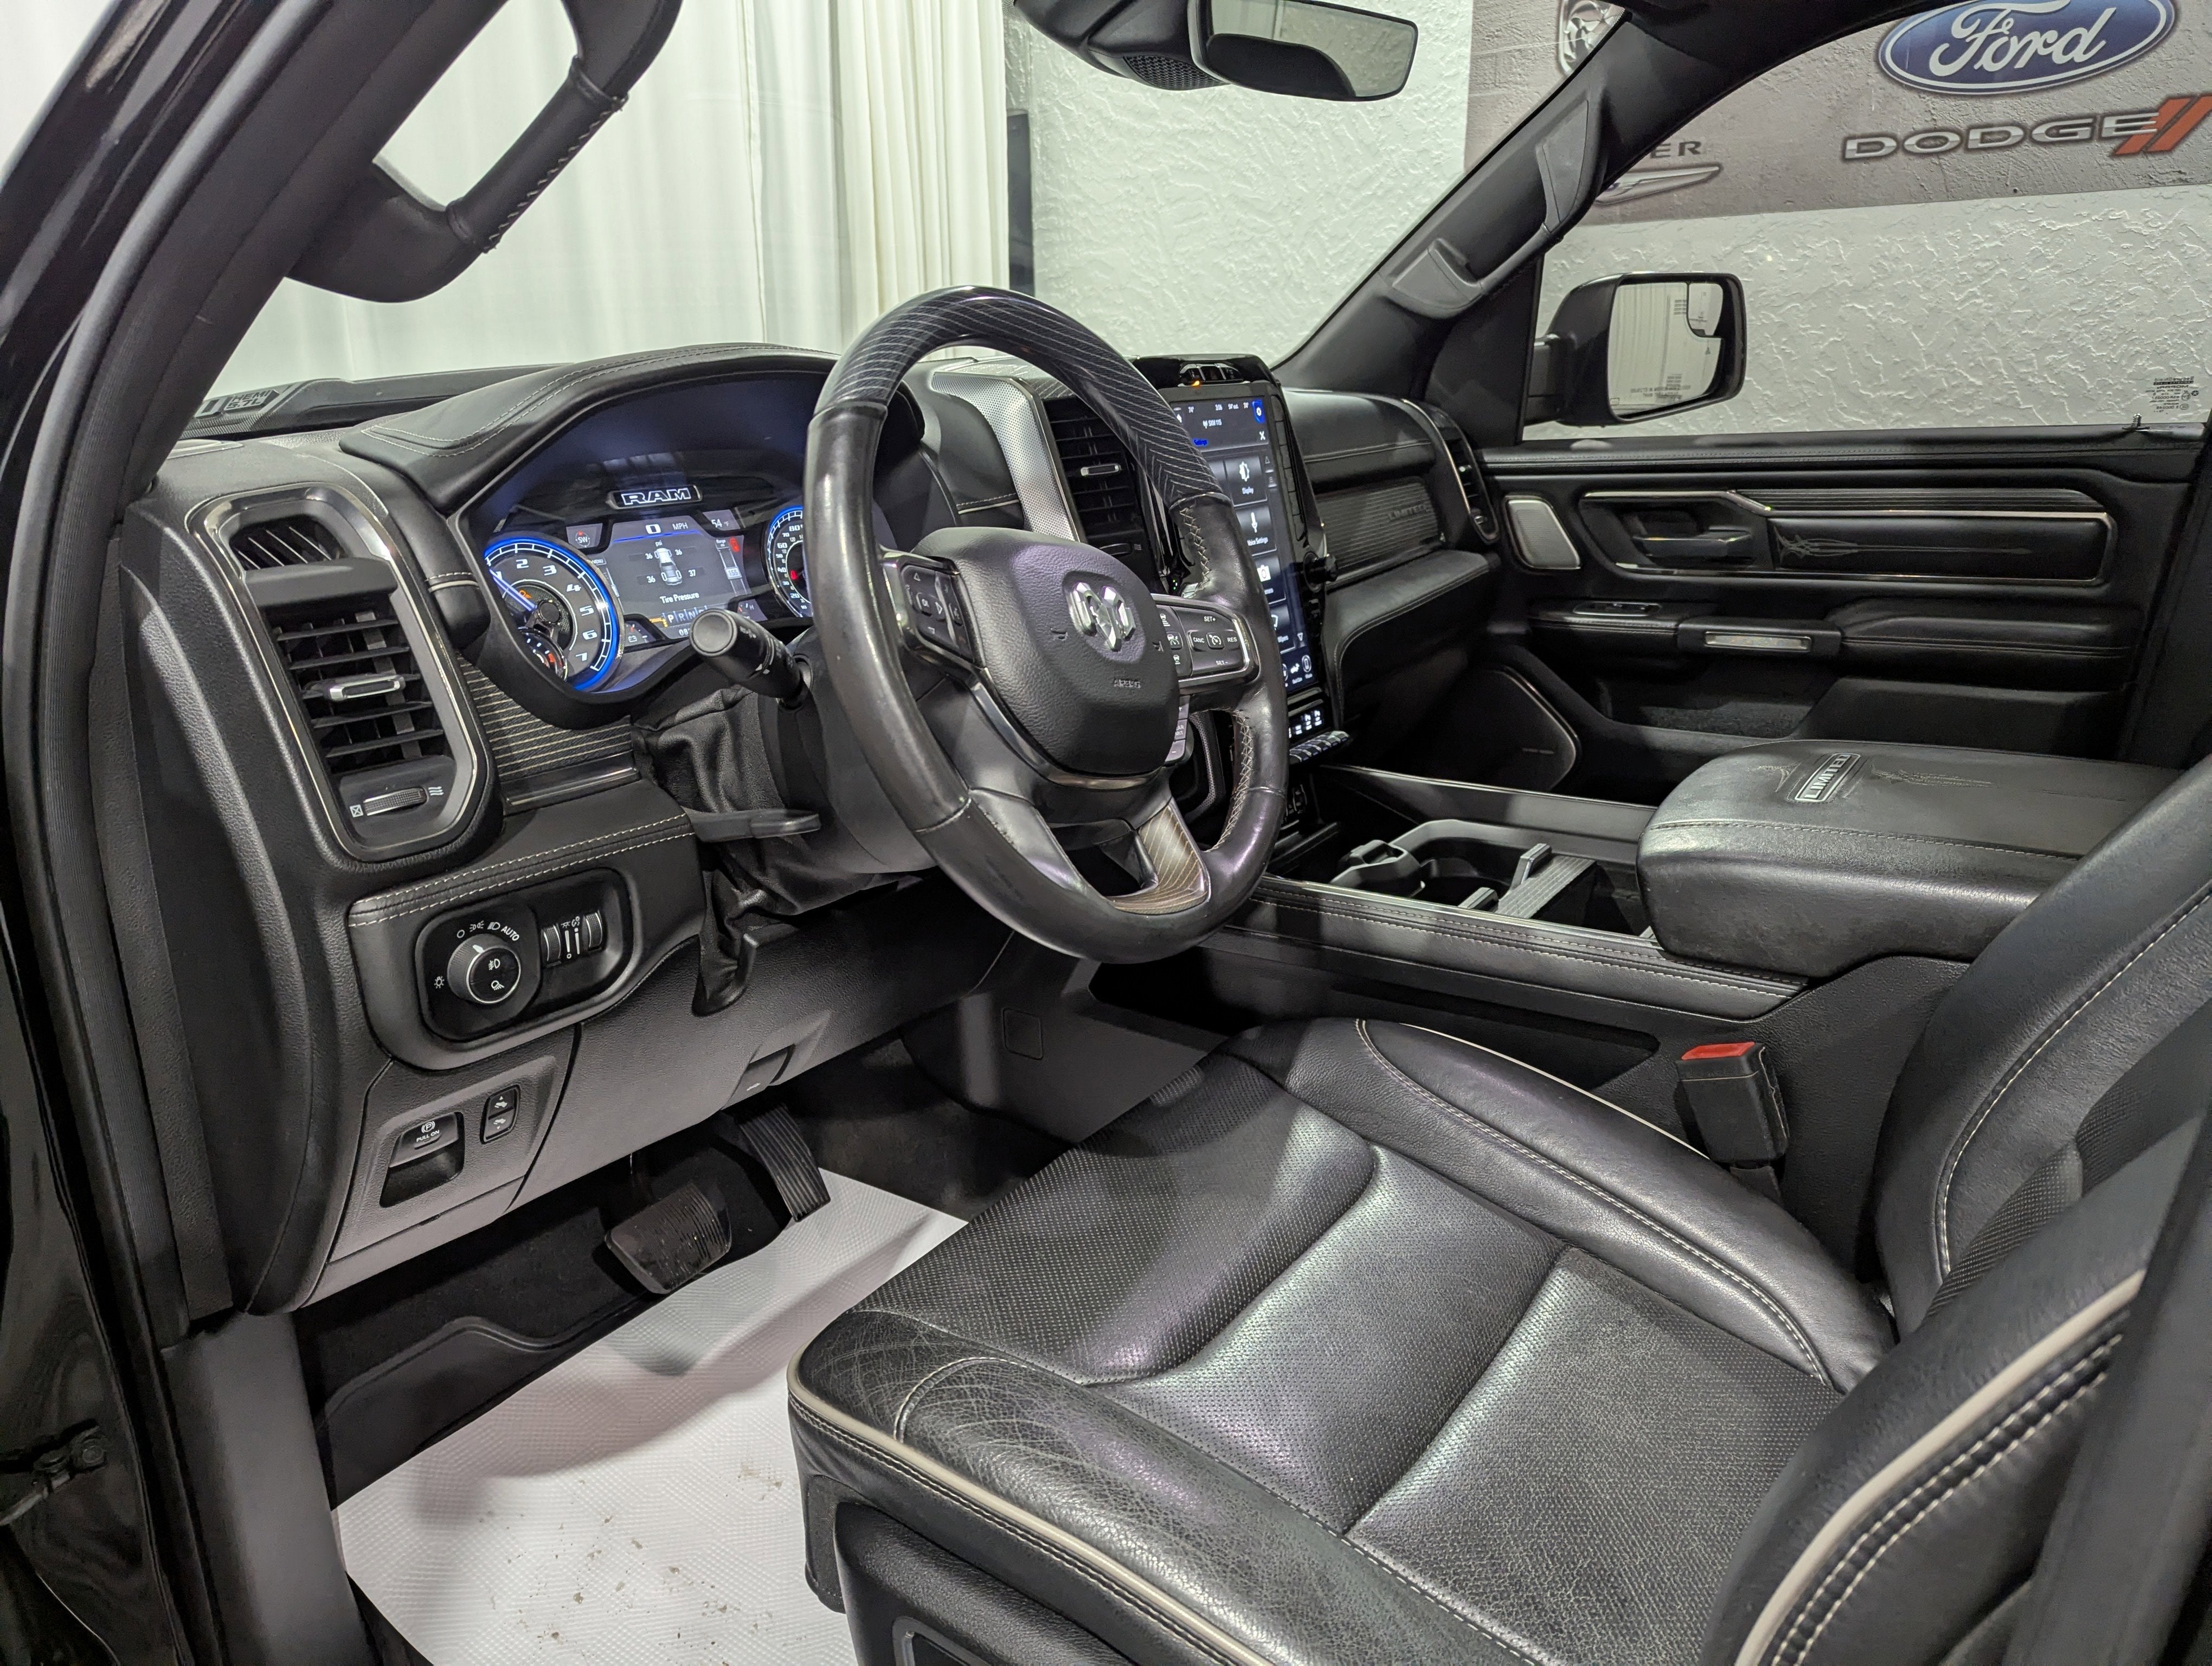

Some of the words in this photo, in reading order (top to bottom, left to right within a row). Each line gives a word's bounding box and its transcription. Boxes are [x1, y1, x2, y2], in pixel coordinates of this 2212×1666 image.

[1929, 0, 2115, 76] Ford
[1845, 112, 2160, 159] DODGE
[232, 390, 270, 401] HEMI
[227, 398, 261, 409] 5.7L
[621, 487, 691, 505] RAM
[1242, 486, 1254, 495] Display
[645, 524, 661, 534] 0
[672, 522, 689, 531] MPH
[711, 518, 723, 528] 54
[1247, 538, 1256, 546] Voice
[1256, 536, 1269, 544] Settings
[516, 559, 529, 569] 2
[543, 565, 557, 576] 3
[647, 575, 655, 584] 36
[566, 584, 582, 592] 4
[659, 595, 673, 604] Tire
[673, 592, 699, 601] Pressure
[579, 605, 594, 616] 5
[667, 614, 674, 623] P
[678, 613, 686, 621] R
[688, 611, 696, 619] N
[582, 630, 597, 640] 6
[575, 652, 588, 662] 7
[1804, 754, 1851, 799] LIMITED
[500, 925, 520, 942] AUTO
[415, 1132, 429, 1143] PULL
[430, 1129, 440, 1138] ON
